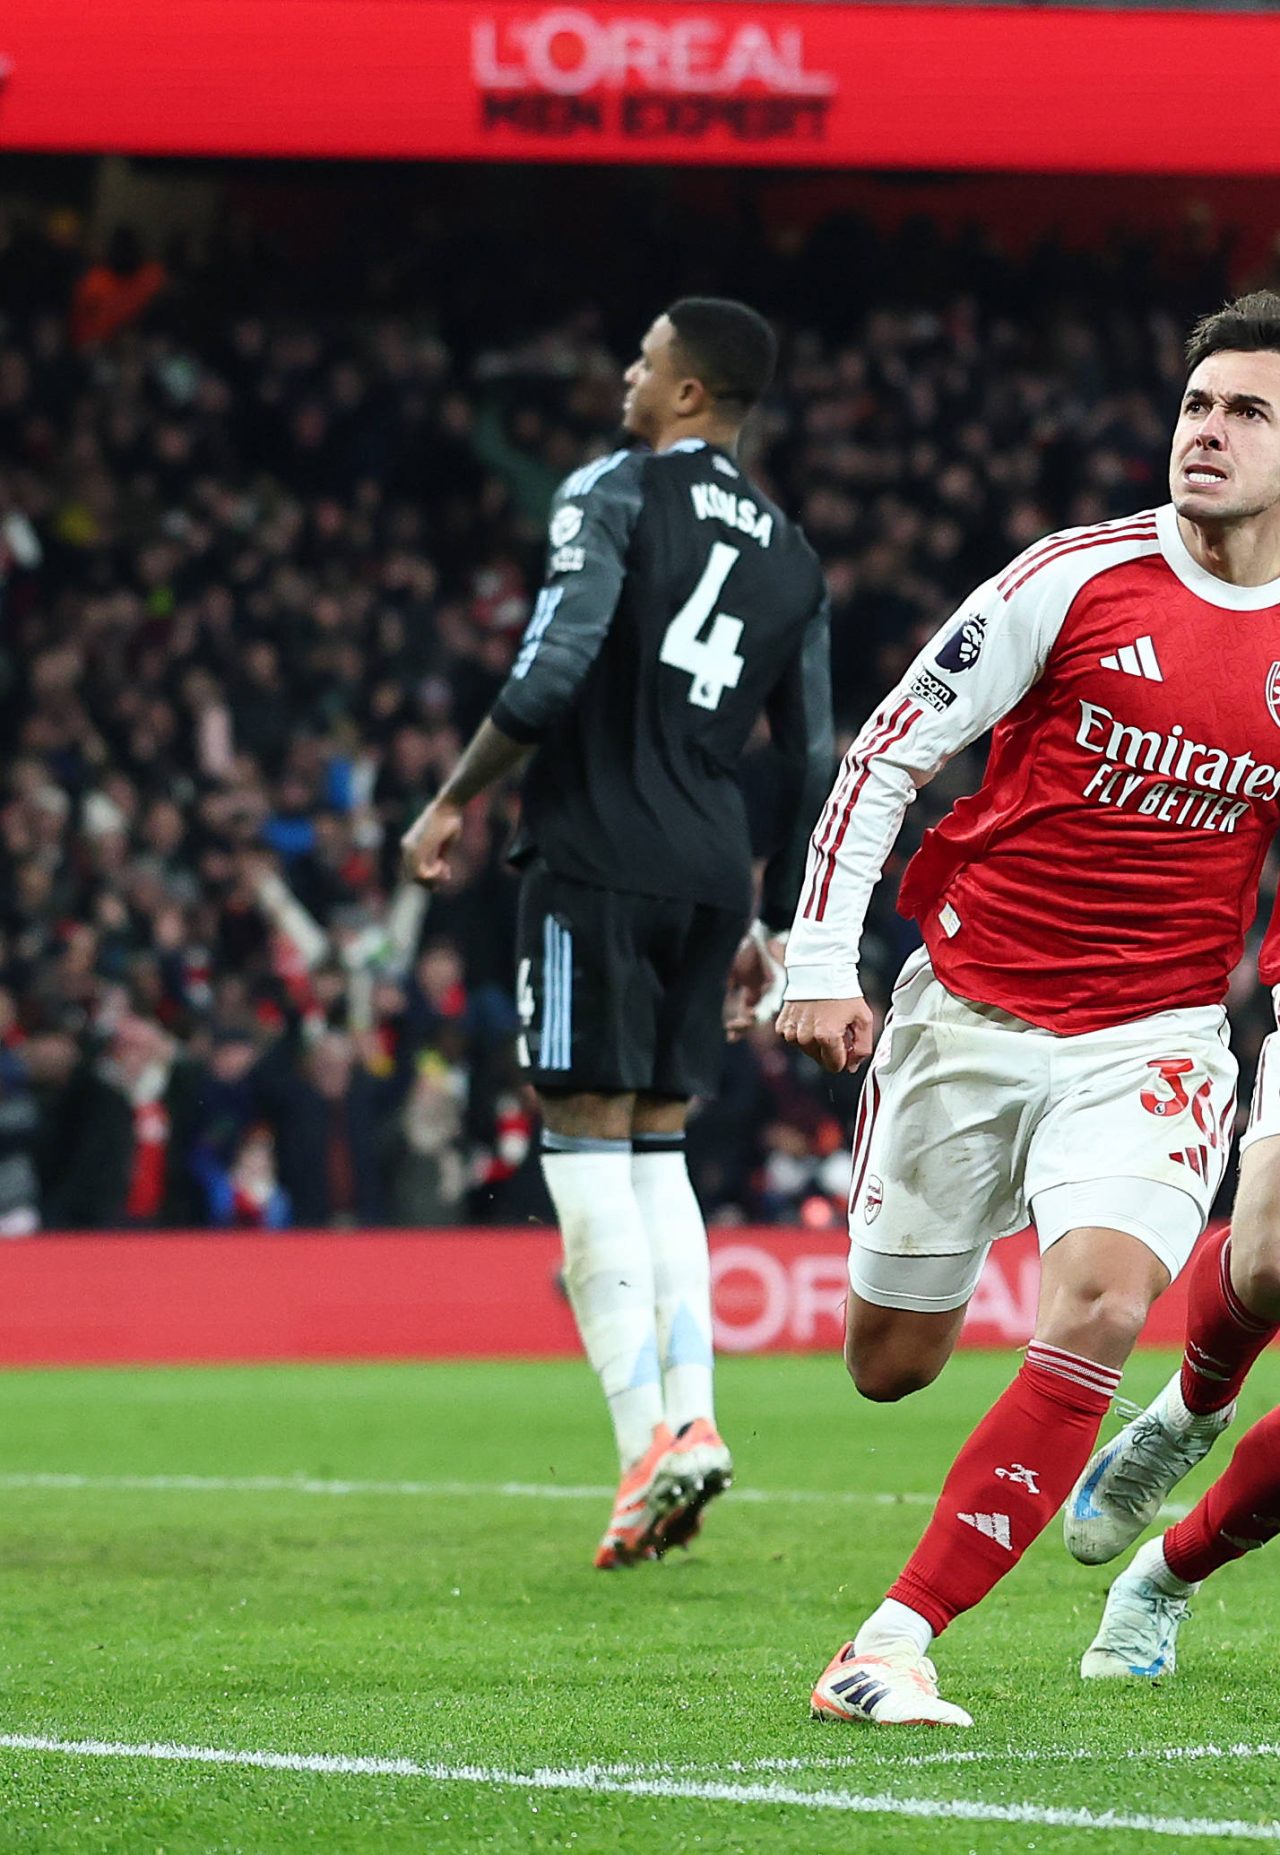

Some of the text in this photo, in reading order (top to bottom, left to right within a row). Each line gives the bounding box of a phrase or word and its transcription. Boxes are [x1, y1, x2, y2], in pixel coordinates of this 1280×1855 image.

[691, 482, 773, 549] KONSA
[660, 541, 744, 711] 4
[1082, 763, 1249, 833] FLY BETTER
